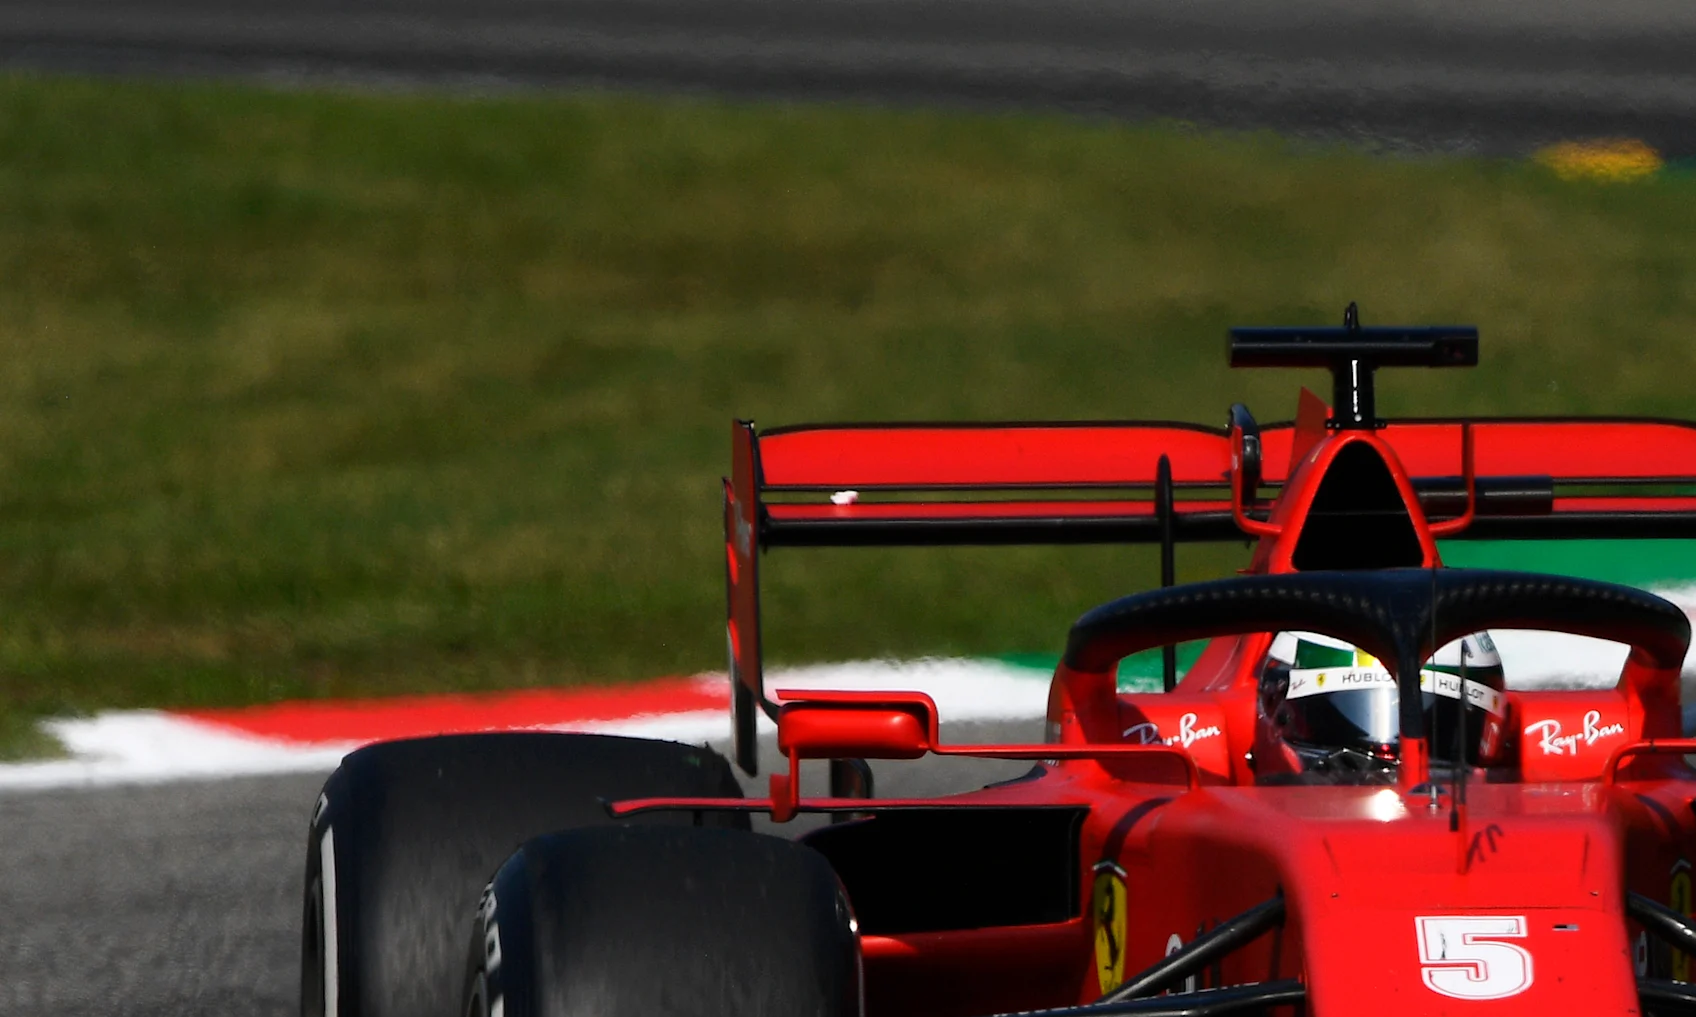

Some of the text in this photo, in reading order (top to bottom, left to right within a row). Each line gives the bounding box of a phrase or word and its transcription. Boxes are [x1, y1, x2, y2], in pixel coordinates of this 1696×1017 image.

[1342, 672, 1393, 684] HUBLO
[1439, 679, 1485, 698] HULOT
[1123, 713, 1221, 748] Ry-Ban
[1524, 710, 1624, 755] Ray-Ban
[1415, 916, 1533, 1000] 5
